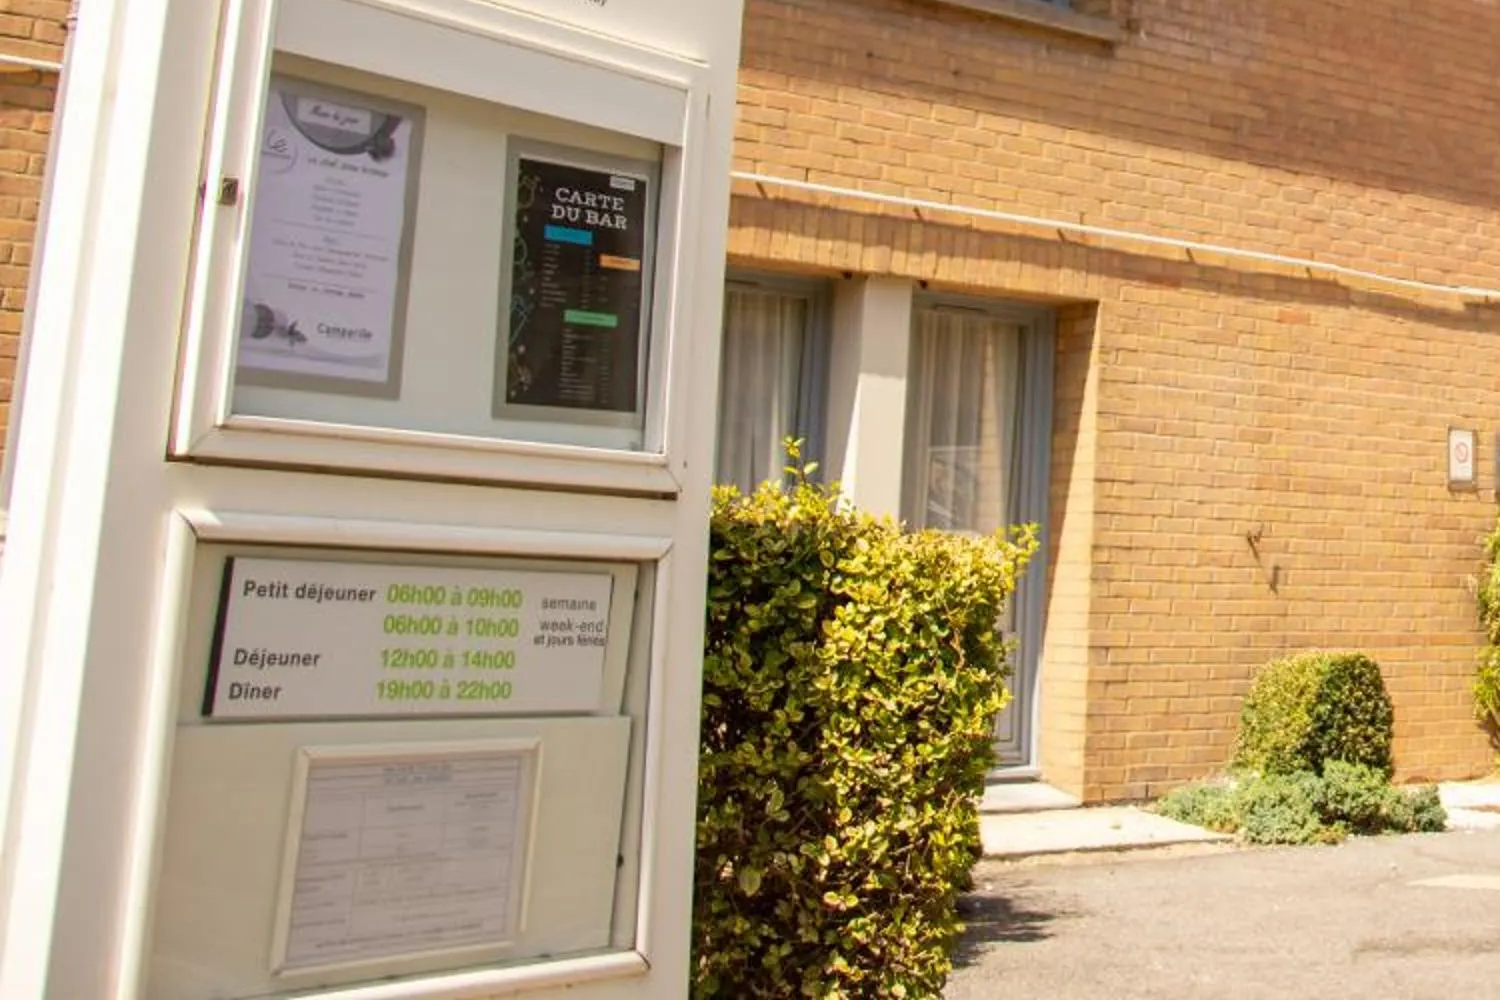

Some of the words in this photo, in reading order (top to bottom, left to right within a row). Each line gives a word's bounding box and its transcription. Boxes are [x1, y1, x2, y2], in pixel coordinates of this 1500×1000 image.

[555, 187, 625, 212] CARTE
[551, 203, 580, 222] DU
[586, 209, 628, 231] BAR
[243, 579, 290, 599] Petit
[295, 582, 378, 604] déjeuner
[387, 583, 446, 605] 06h00
[467, 587, 523, 608] 09h00
[383, 614, 442, 636] 06h00
[466, 618, 519, 638] 10h00
[233, 648, 322, 671] Déjeuner
[381, 649, 438, 669] 12h00
[463, 650, 515, 670] 14h00
[377, 680, 433, 700] 19h00
[457, 681, 512, 700] 22h00
